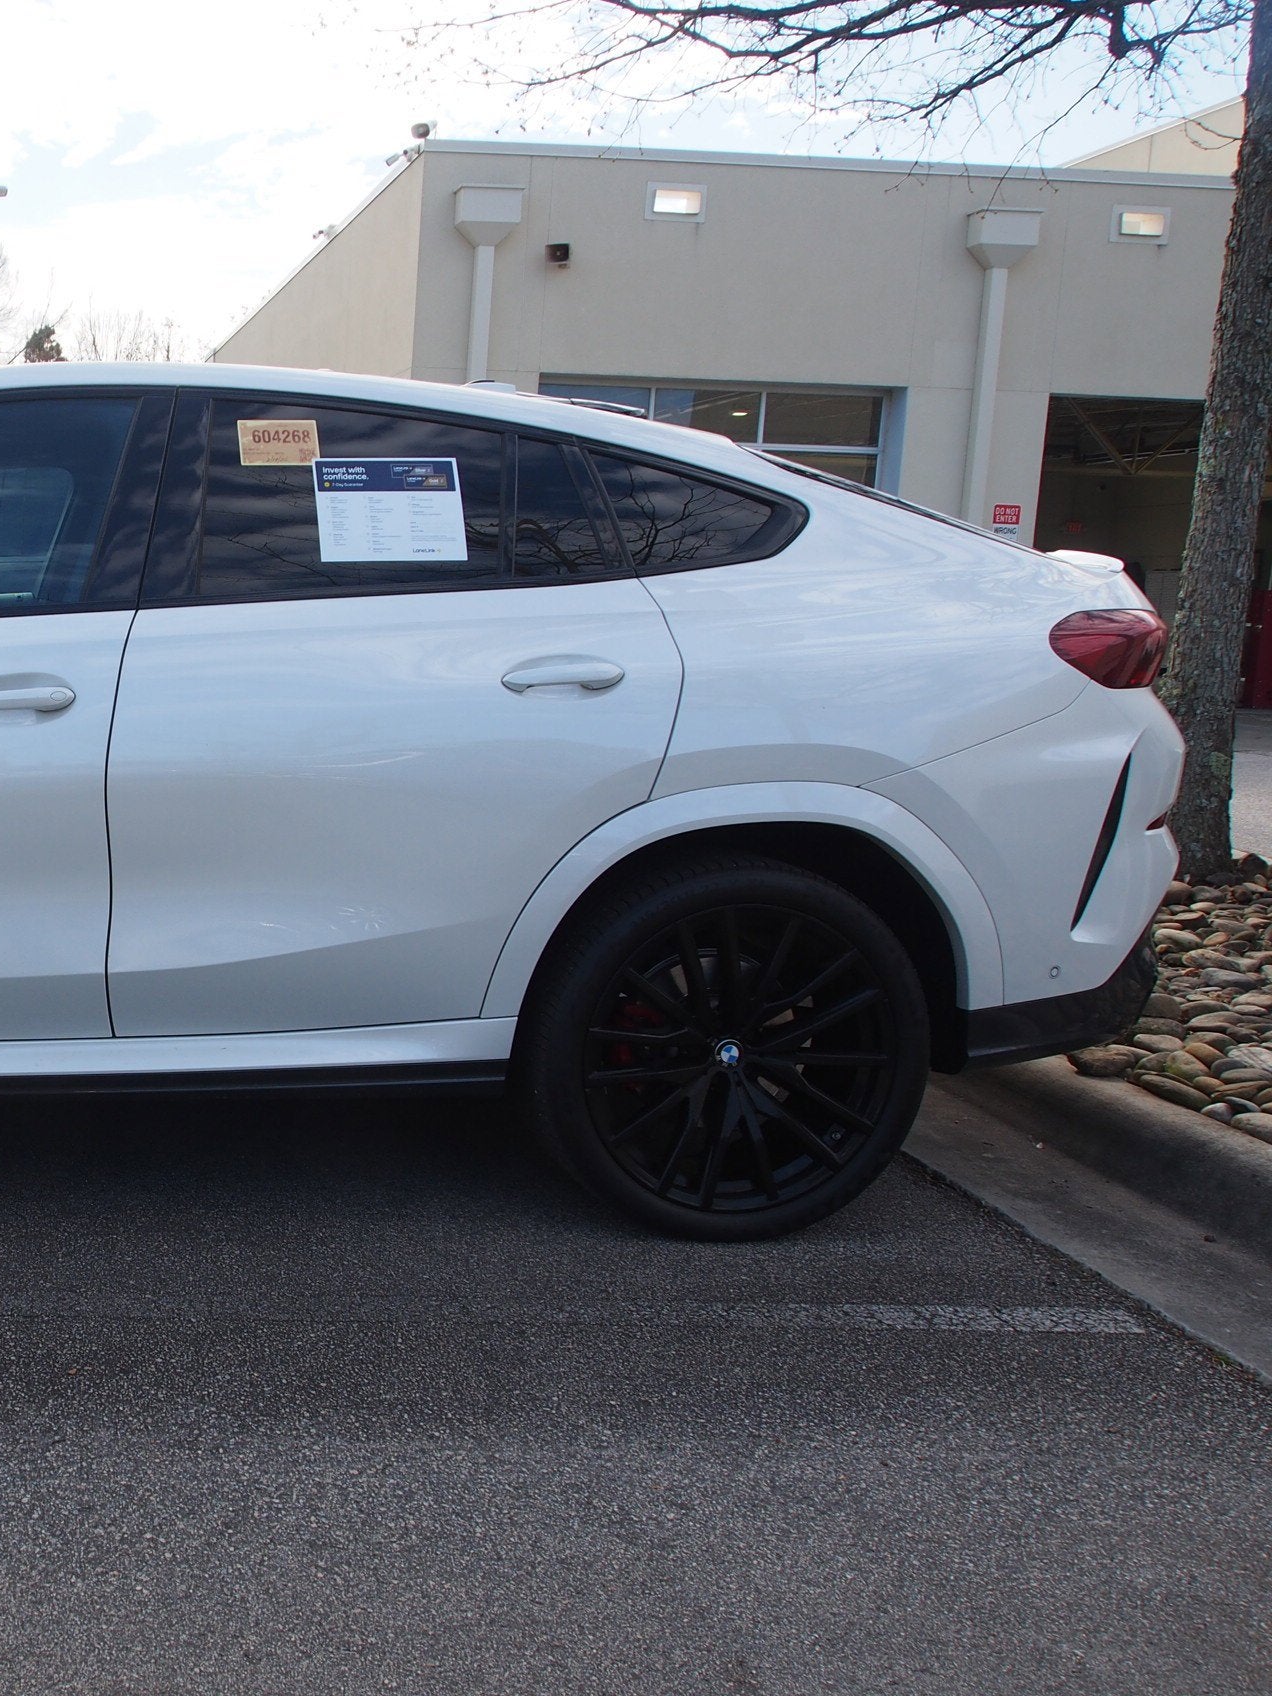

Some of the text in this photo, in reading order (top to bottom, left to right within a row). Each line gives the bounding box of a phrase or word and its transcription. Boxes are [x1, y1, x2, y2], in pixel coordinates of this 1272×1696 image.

[252, 429, 311, 443] 604268
[322, 466, 366, 474] Invest with
[323, 473, 369, 481] confidence.
[995, 507, 1020, 515] DO NOT
[995, 515, 1017, 523] ENTER
[993, 526, 1017, 535] WRONG
